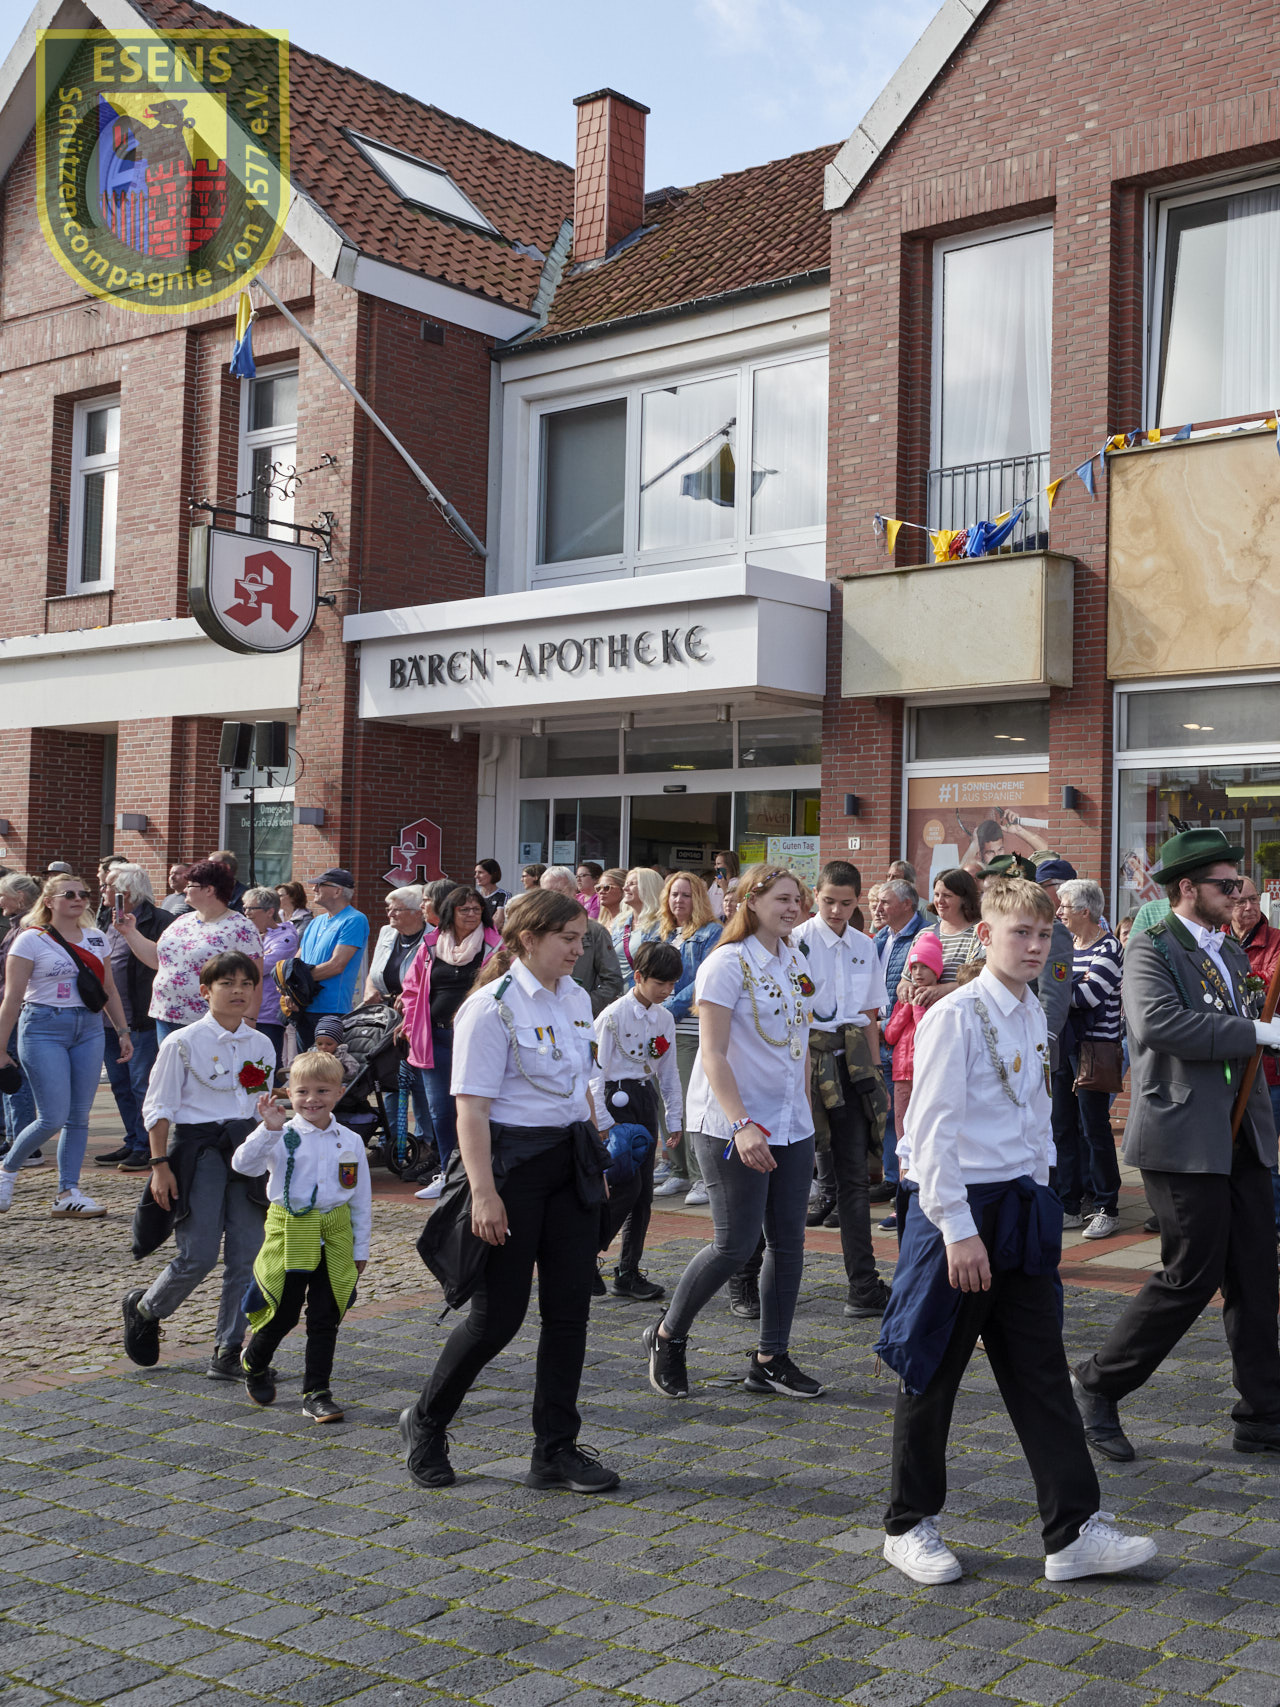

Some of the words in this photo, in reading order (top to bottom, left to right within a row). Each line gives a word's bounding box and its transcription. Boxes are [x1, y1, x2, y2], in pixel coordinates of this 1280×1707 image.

[962, 781, 1025, 791] SONNENCREME
[939, 783, 959, 802] #1
[962, 792, 980, 802] AUS
[260, 803, 290, 816] Omega-3
[241, 817, 251, 827] Die
[280, 816, 293, 827] dem
[782, 842, 801, 850] Guten
[803, 841, 815, 851] Tag
[850, 839, 858, 849] 17
